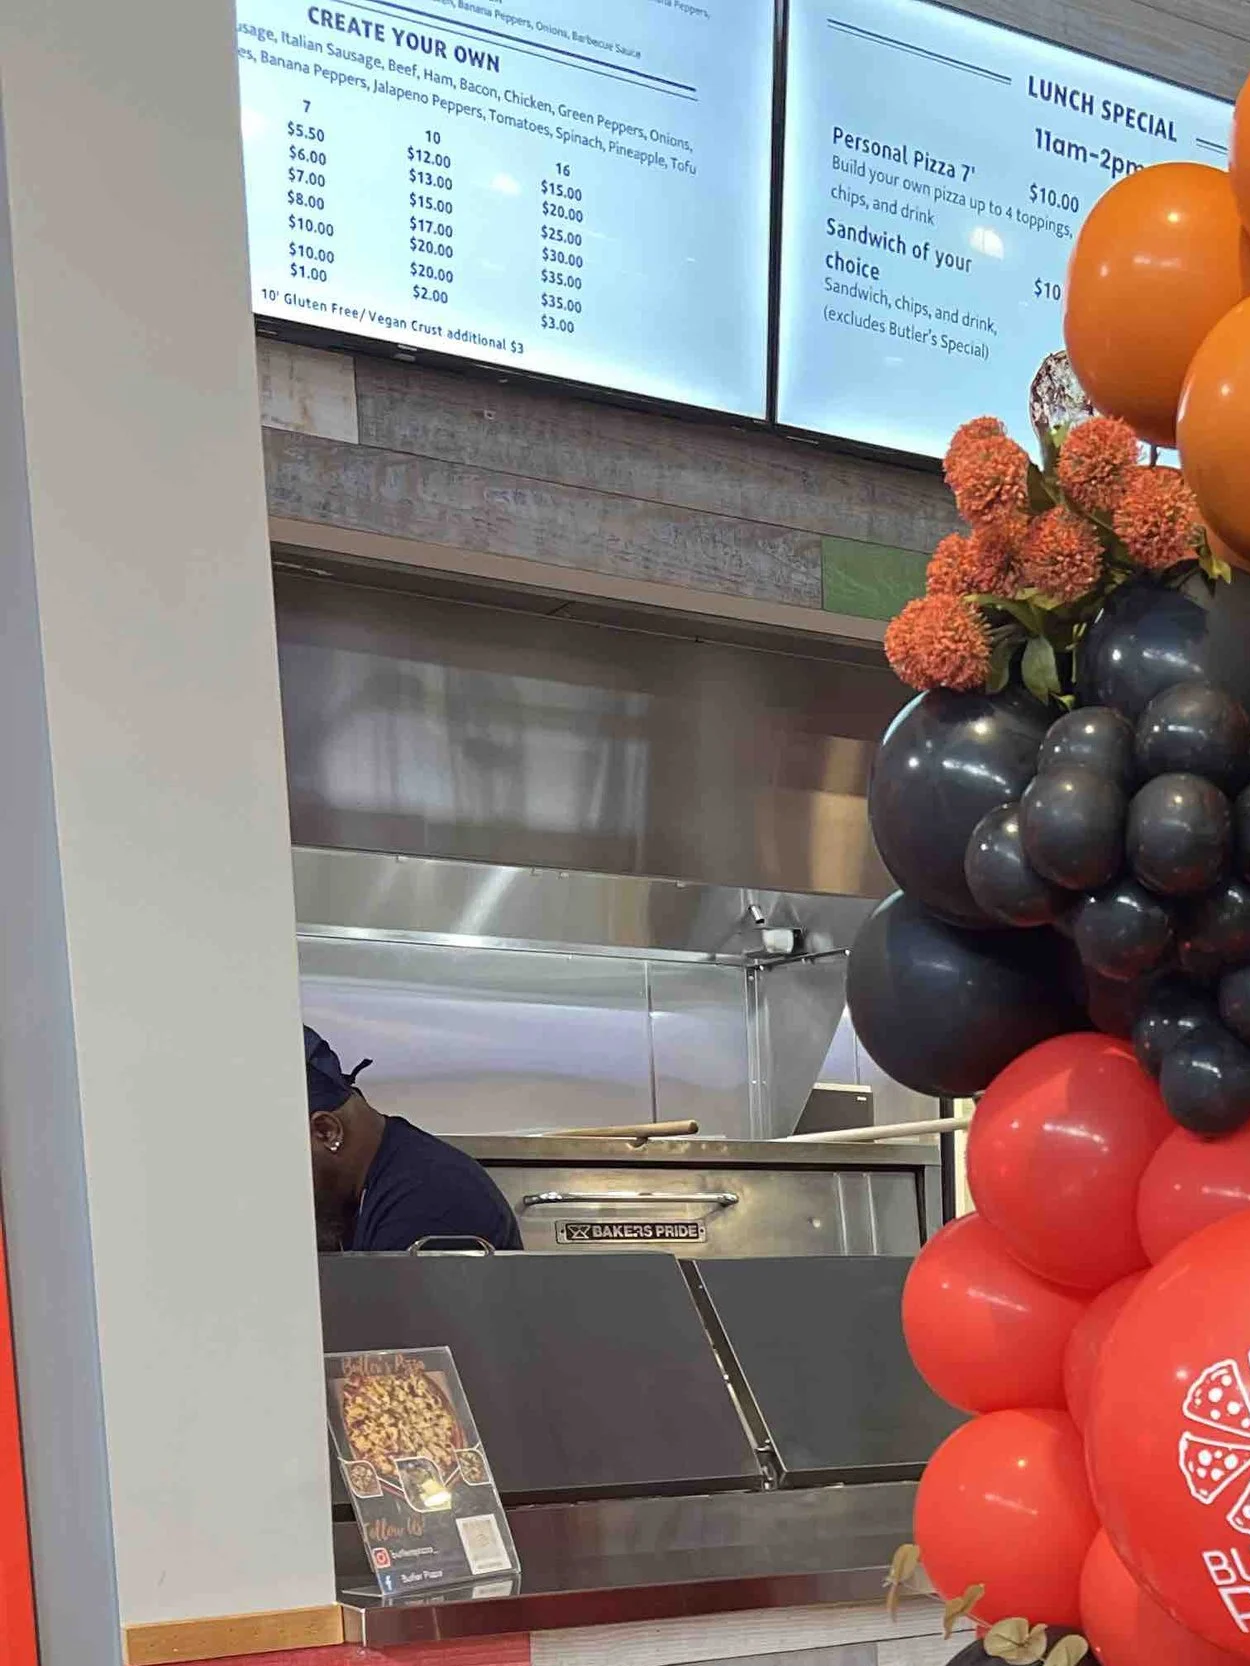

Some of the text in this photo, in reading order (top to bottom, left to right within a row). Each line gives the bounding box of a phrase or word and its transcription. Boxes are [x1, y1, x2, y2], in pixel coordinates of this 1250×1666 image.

[307, 6, 500, 73] CREATE YOUR OWN
[281, 30, 323, 54] Italian
[327, 42, 385, 70] Sausage,
[388, 58, 421, 80] Beef,
[423, 69, 457, 91] Ham,
[459, 78, 501, 102] Bacon,
[504, 89, 556, 116] Chicken,
[558, 103, 594, 126] Green
[597, 113, 648, 141] Peppers,
[649, 128, 694, 153] Onions,
[260, 50, 310, 75] Banana
[314, 64, 371, 92] Peppers,
[372, 79, 429, 105] Jalapeno
[432, 95, 487, 122] Peppers,
[489, 108, 553, 139] Tomatoes,
[556, 128, 606, 153] Spinach,
[608, 140, 668, 170] Pineapple,
[671, 157, 697, 176] Tofu
[303, 100, 311, 113] 7
[1028, 75, 1178, 143] LUNCH SPECIAL
[287, 120, 325, 142] $5.50
[425, 130, 441, 145] 10
[289, 144, 327, 166] $6.00
[407, 146, 451, 169] $12.00
[832, 126, 976, 183] Personal Pizza 7'
[288, 166, 326, 187] $7.00
[409, 168, 453, 190] $13.00
[555, 162, 571, 177] 16
[287, 189, 325, 210] $8.00
[541, 179, 582, 202] $15.00
[832, 154, 1074, 240] Build your own pizza up to 4 toppings,
[1029, 182, 1080, 213] $10.00
[409, 191, 453, 215] $15.00
[542, 200, 584, 223] $20.00
[830, 184, 936, 226] chips, and drink
[288, 213, 334, 237] $10.00
[409, 215, 453, 238] $17.00
[541, 225, 582, 246] $25.00
[289, 241, 335, 264] $10.00
[409, 236, 454, 259] $20.00
[826, 217, 973, 273] Sandwich of your
[542, 246, 584, 269] $30.00
[825, 251, 880, 281] choice
[290, 262, 327, 282] $1.00
[410, 261, 454, 284] $20.00
[541, 269, 582, 290] $35.00
[413, 284, 449, 304] $2.00
[541, 293, 582, 314] $35.00
[824, 276, 998, 336] Sandwich, chips, and drink,
[284, 293, 327, 313] Gluten
[411, 320, 443, 338] Crust
[447, 328, 507, 351] additional
[510, 340, 524, 355] $3
[541, 314, 575, 334] $3.00
[822, 304, 990, 361] (excludes Butler's Special)
[655, 1224, 698, 1238] PRIDE
